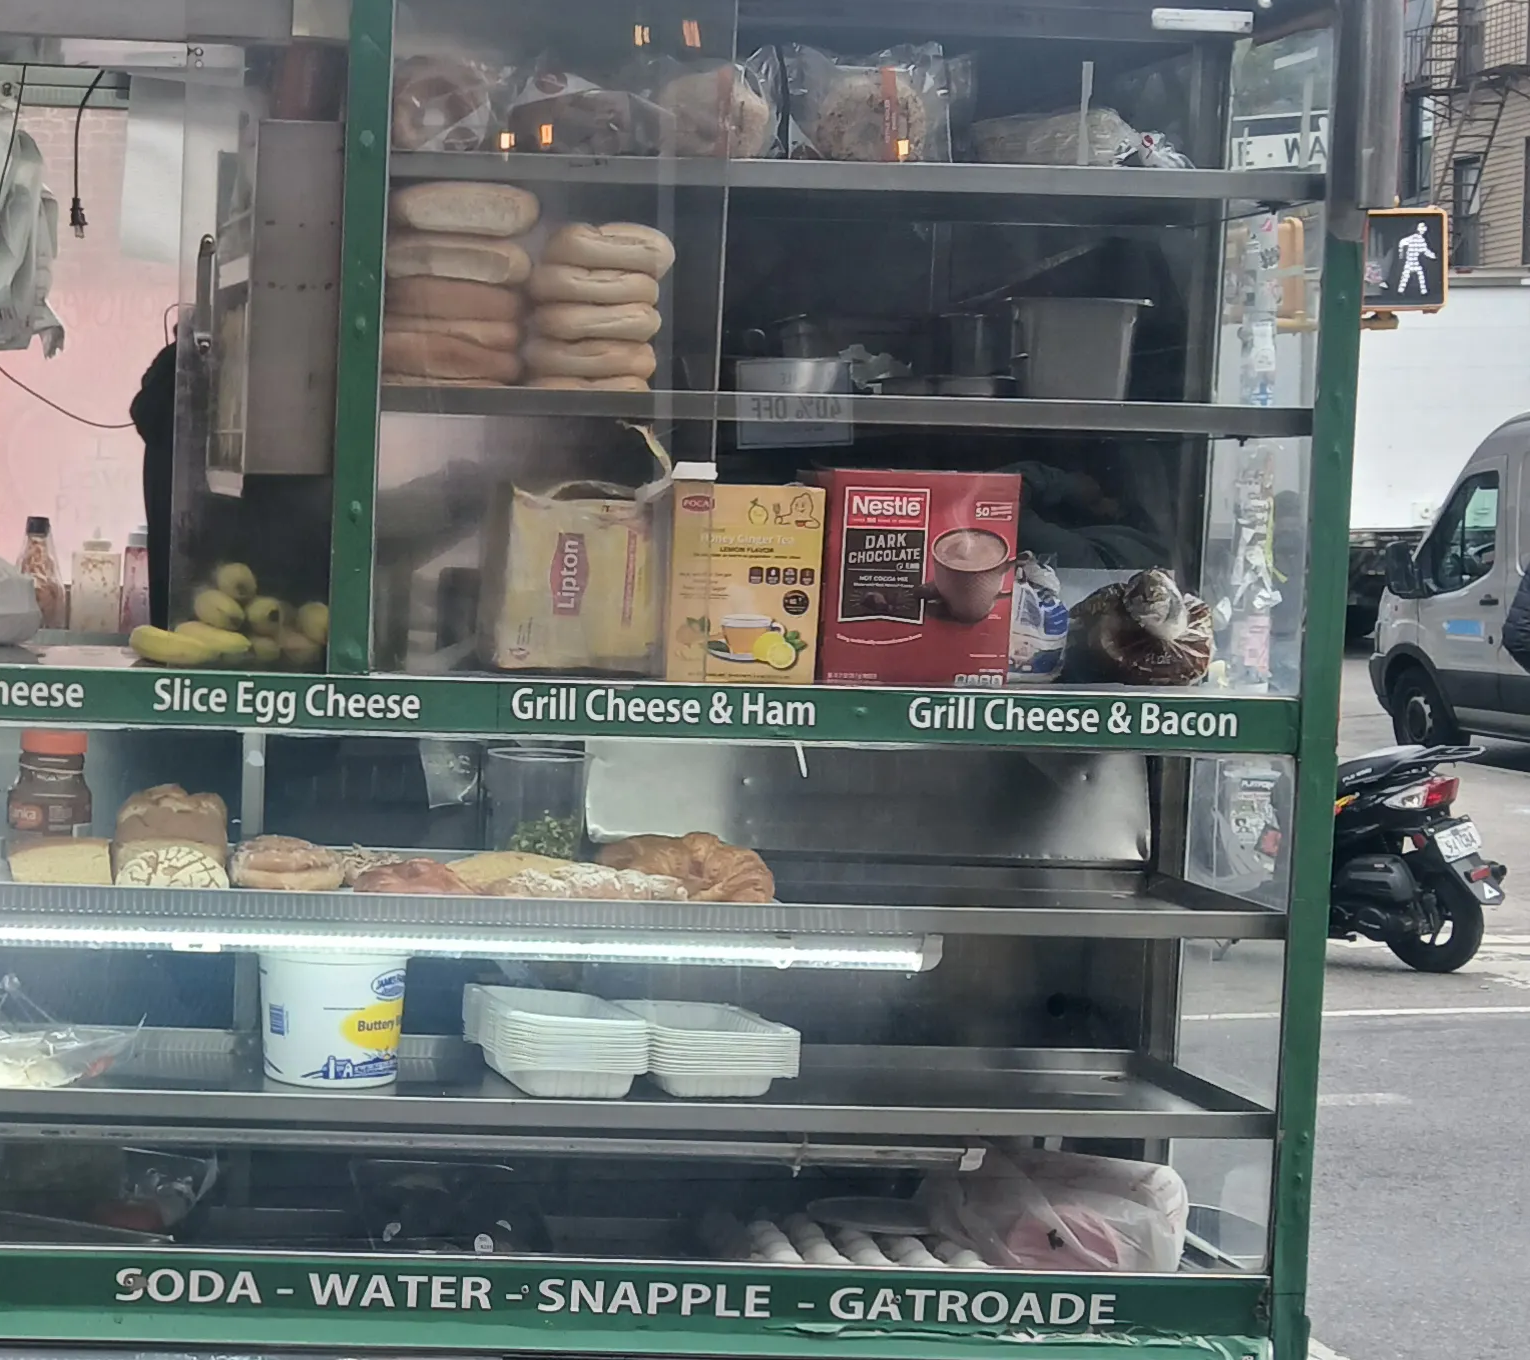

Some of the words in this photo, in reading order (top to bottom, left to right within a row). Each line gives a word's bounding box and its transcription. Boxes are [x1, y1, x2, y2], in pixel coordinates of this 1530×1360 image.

[975, 507, 989, 517] 50
[865, 533, 907, 549] DARK
[848, 549, 920, 563] CHOCOLATE
[557, 540, 580, 608] Lipton
[908, 696, 975, 729] Grill
[984, 698, 1100, 733] Cheese
[1107, 702, 1131, 734] &
[1140, 703, 1237, 737] Bacon
[358, 1020, 394, 1032] Buttery
[115, 1268, 262, 1305] SODA
[309, 1272, 491, 1310] WATER
[537, 1278, 771, 1318] SNAPPLE
[830, 1286, 1116, 1325] GATROADE
